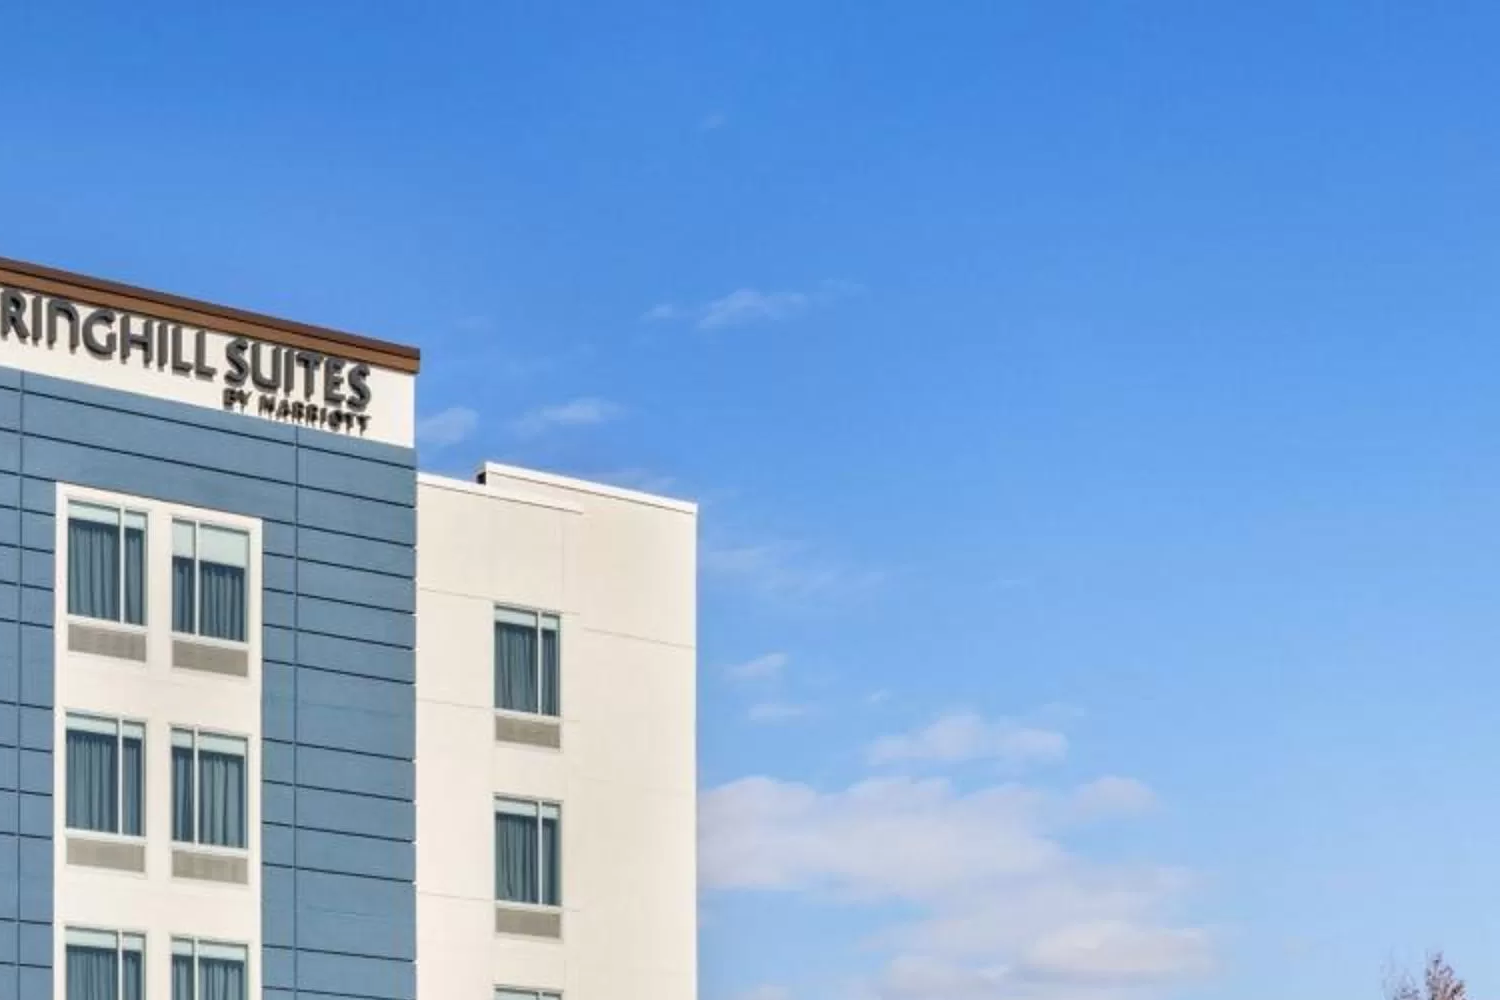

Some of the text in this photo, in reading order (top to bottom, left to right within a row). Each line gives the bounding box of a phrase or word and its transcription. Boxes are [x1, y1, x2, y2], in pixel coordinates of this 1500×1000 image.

[223, 335, 372, 412] SUITES
[222, 386, 372, 436] BY MARRIOTT
